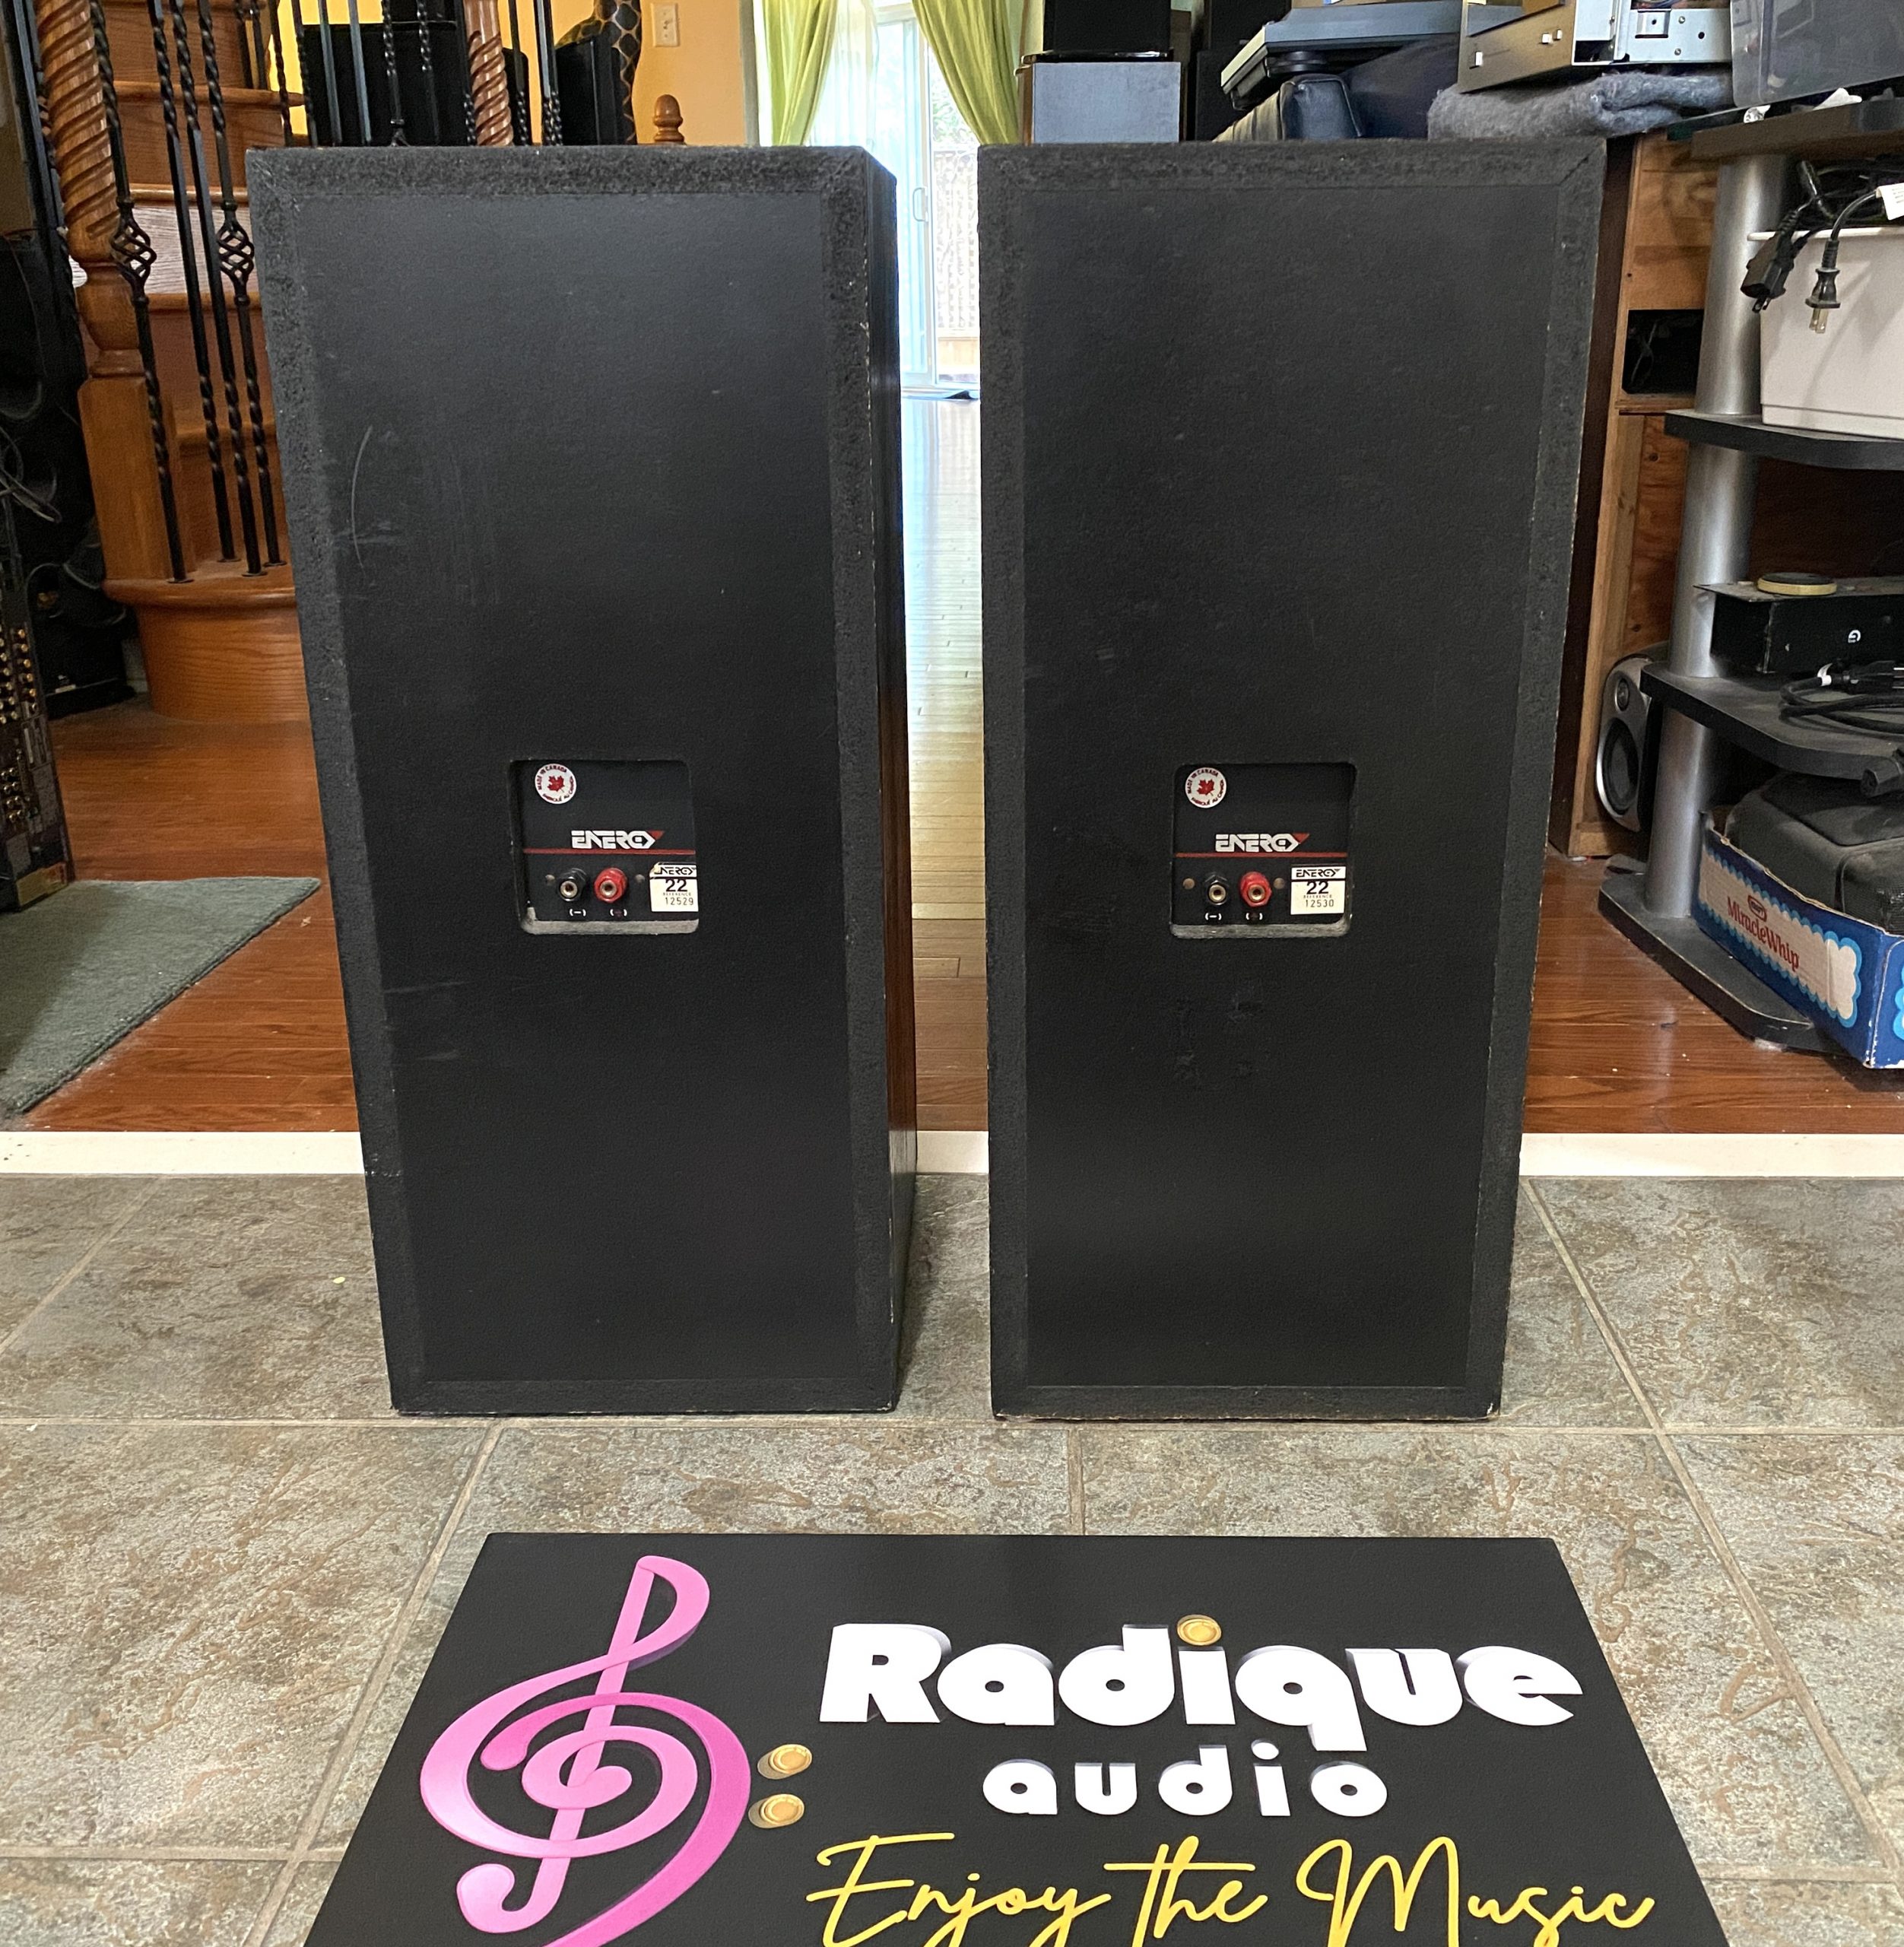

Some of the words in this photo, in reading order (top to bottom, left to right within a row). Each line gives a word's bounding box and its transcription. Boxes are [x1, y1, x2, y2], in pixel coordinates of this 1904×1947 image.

[665, 878, 687, 892] 22
[1306, 880, 1329, 894] 22
[665, 897, 693, 906] 12529
[1306, 899, 1334, 907] 12530
[818, 1614, 1583, 1751] Radique
[982, 1740, 1388, 1816] audio
[806, 1832, 1111, 1947] Enjoy
[1296, 1836, 1655, 1947] Music
